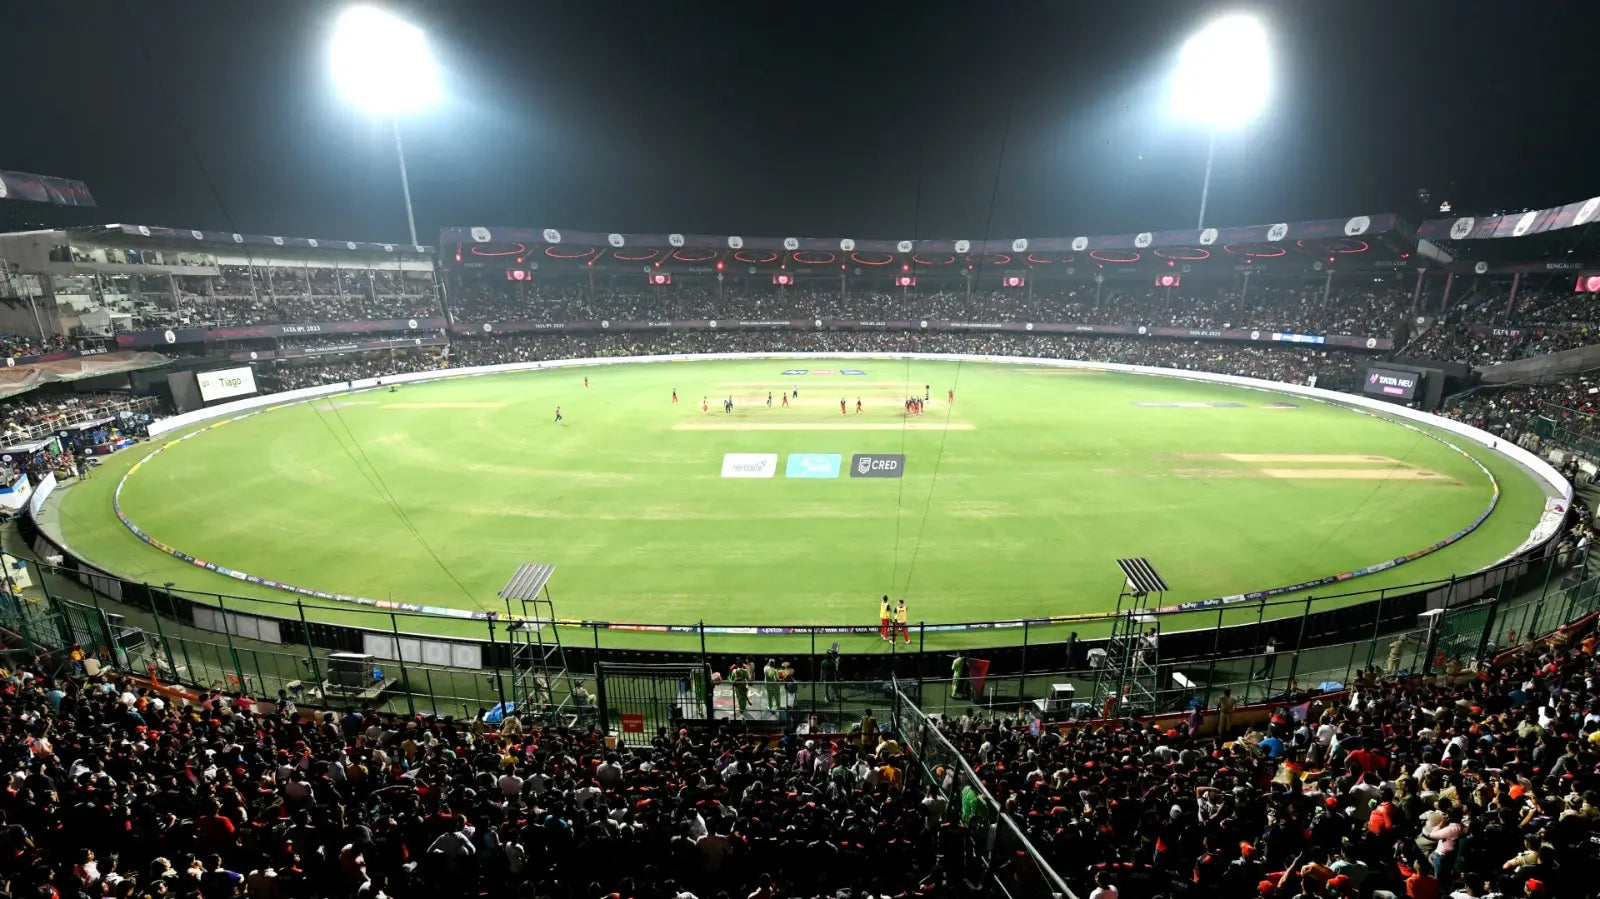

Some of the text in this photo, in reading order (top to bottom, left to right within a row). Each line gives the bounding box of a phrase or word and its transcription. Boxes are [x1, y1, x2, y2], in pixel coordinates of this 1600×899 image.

[218, 377, 242, 388] Tiago
[1379, 376, 1413, 388] TATA NEU
[871, 460, 897, 470] CRED
